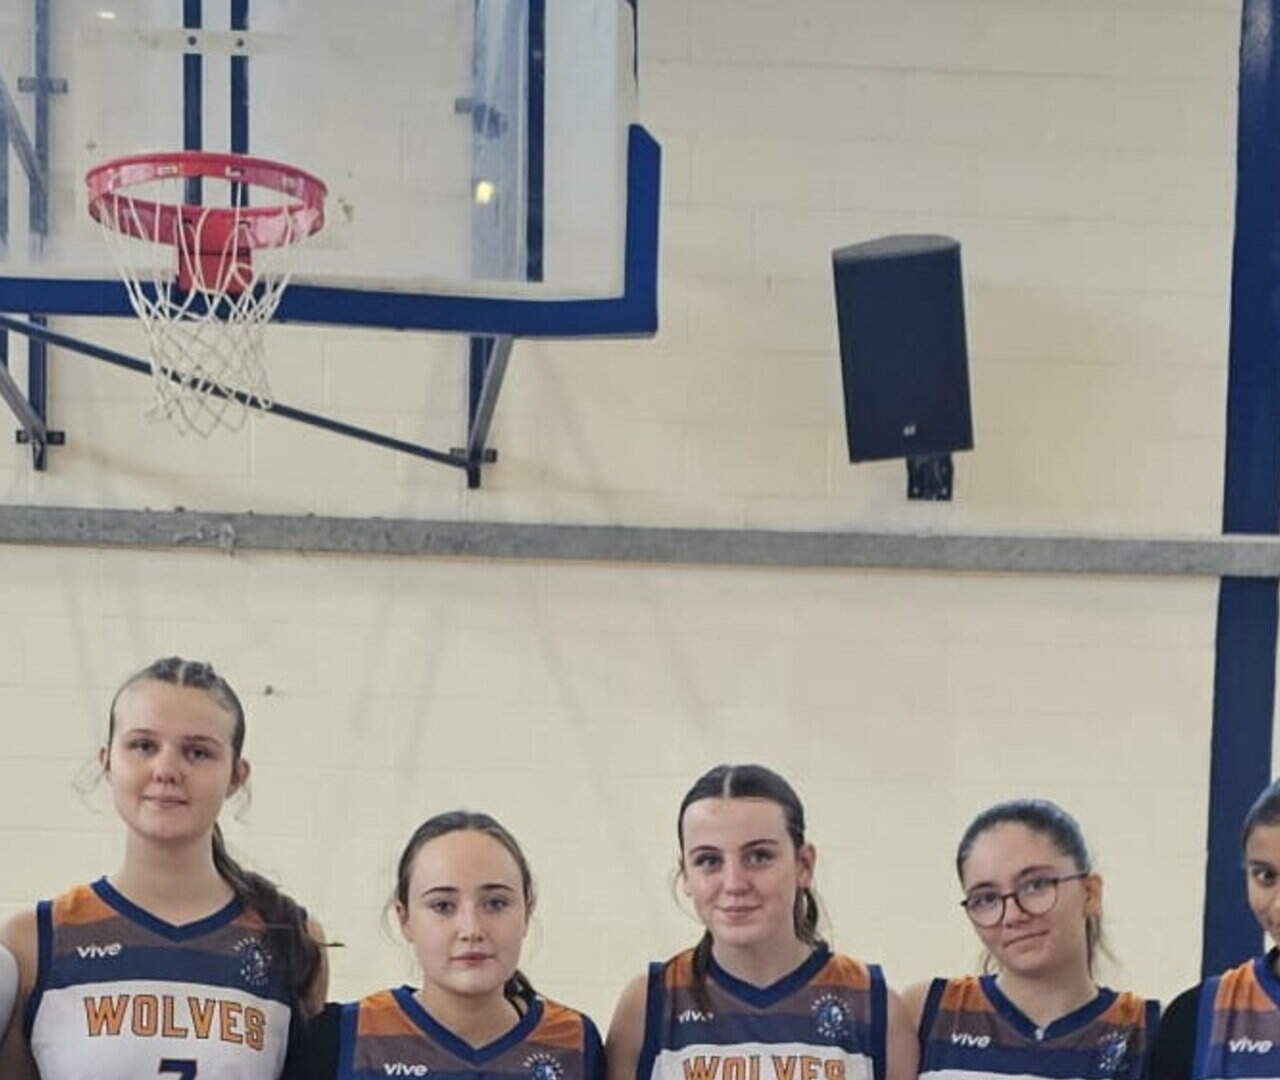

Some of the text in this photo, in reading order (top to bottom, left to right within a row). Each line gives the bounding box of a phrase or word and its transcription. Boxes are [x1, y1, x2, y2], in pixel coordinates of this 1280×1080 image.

[76, 943, 122, 959] vive
[83, 993, 266, 1050] WOLVES
[950, 1032, 991, 1048] vive
[1228, 1036, 1272, 1053] vive
[383, 1061, 428, 1077] vive
